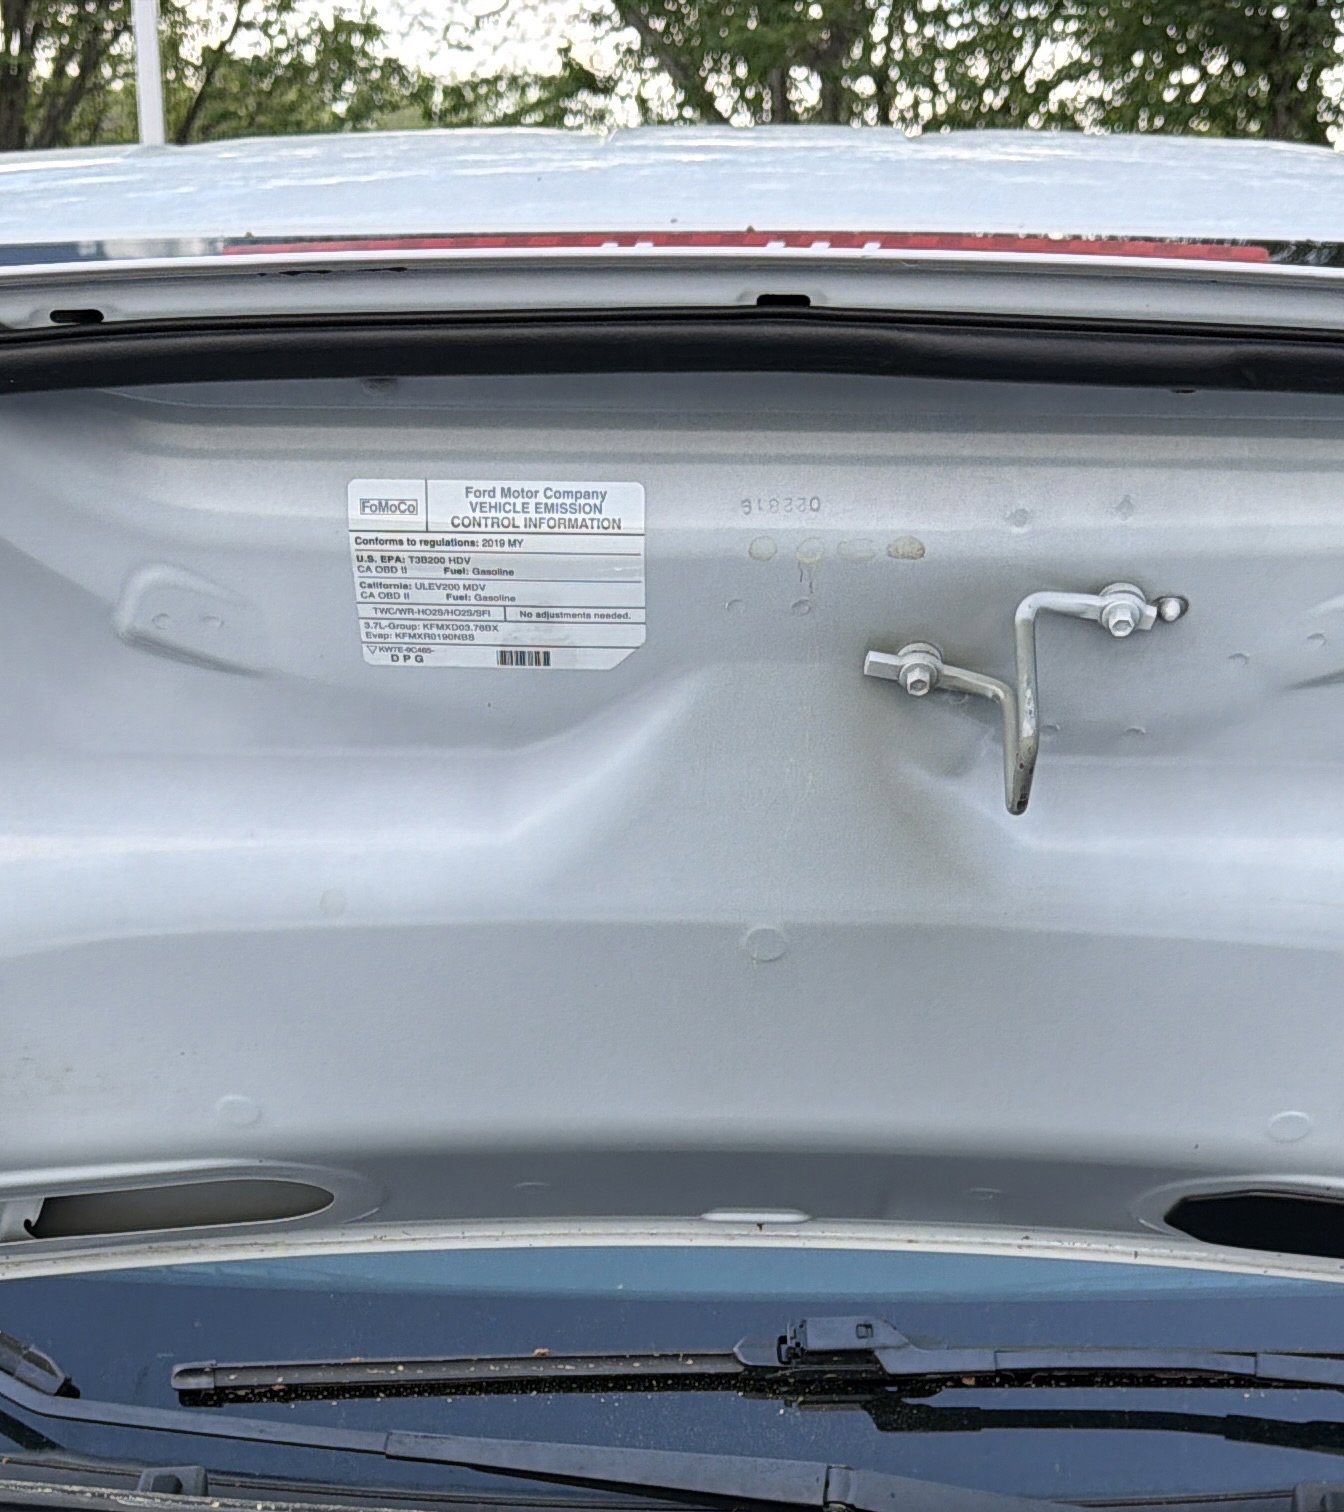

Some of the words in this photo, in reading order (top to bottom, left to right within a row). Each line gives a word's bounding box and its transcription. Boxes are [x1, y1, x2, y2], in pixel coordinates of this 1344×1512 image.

[465, 487, 496, 499] Ford
[500, 487, 539, 500] Motor
[544, 488, 607, 502] Company
[361, 501, 416, 514] FoMoCo
[469, 502, 530, 514] VEHICLE
[534, 502, 602, 515] EMISSION
[451, 516, 519, 529] CONTROL
[524, 517, 621, 530] INFORMATION
[354, 537, 403, 546] Conforms
[406, 537, 416, 547] to
[419, 538, 479, 549] regulations:
[481, 539, 505, 548] 2019
[507, 539, 524, 548] MY
[356, 555, 377, 564] U.S.
[380, 555, 405, 564] EPA:
[448, 556, 471, 565] HDV
[357, 565, 375, 574] CA
[376, 566, 398, 574] OBD
[401, 566, 407, 574] II
[443, 567, 469, 575] Fuel:
[472, 567, 514, 576] Gasoline
[359, 581, 412, 590] California:
[414, 582, 460, 591] ULEV200
[462, 583, 486, 591] MDV
[360, 591, 376, 600] CA
[378, 592, 401, 600] OBD
[403, 592, 410, 600] II
[446, 593, 472, 601] Fuel:
[474, 594, 516, 602] Gasoline
[519, 610, 533, 619] No
[535, 611, 591, 620] adjustments
[593, 611, 631, 620] needed.
[364, 622, 420, 632] 3.7L-Group:
[365, 631, 392, 641] Evap:
